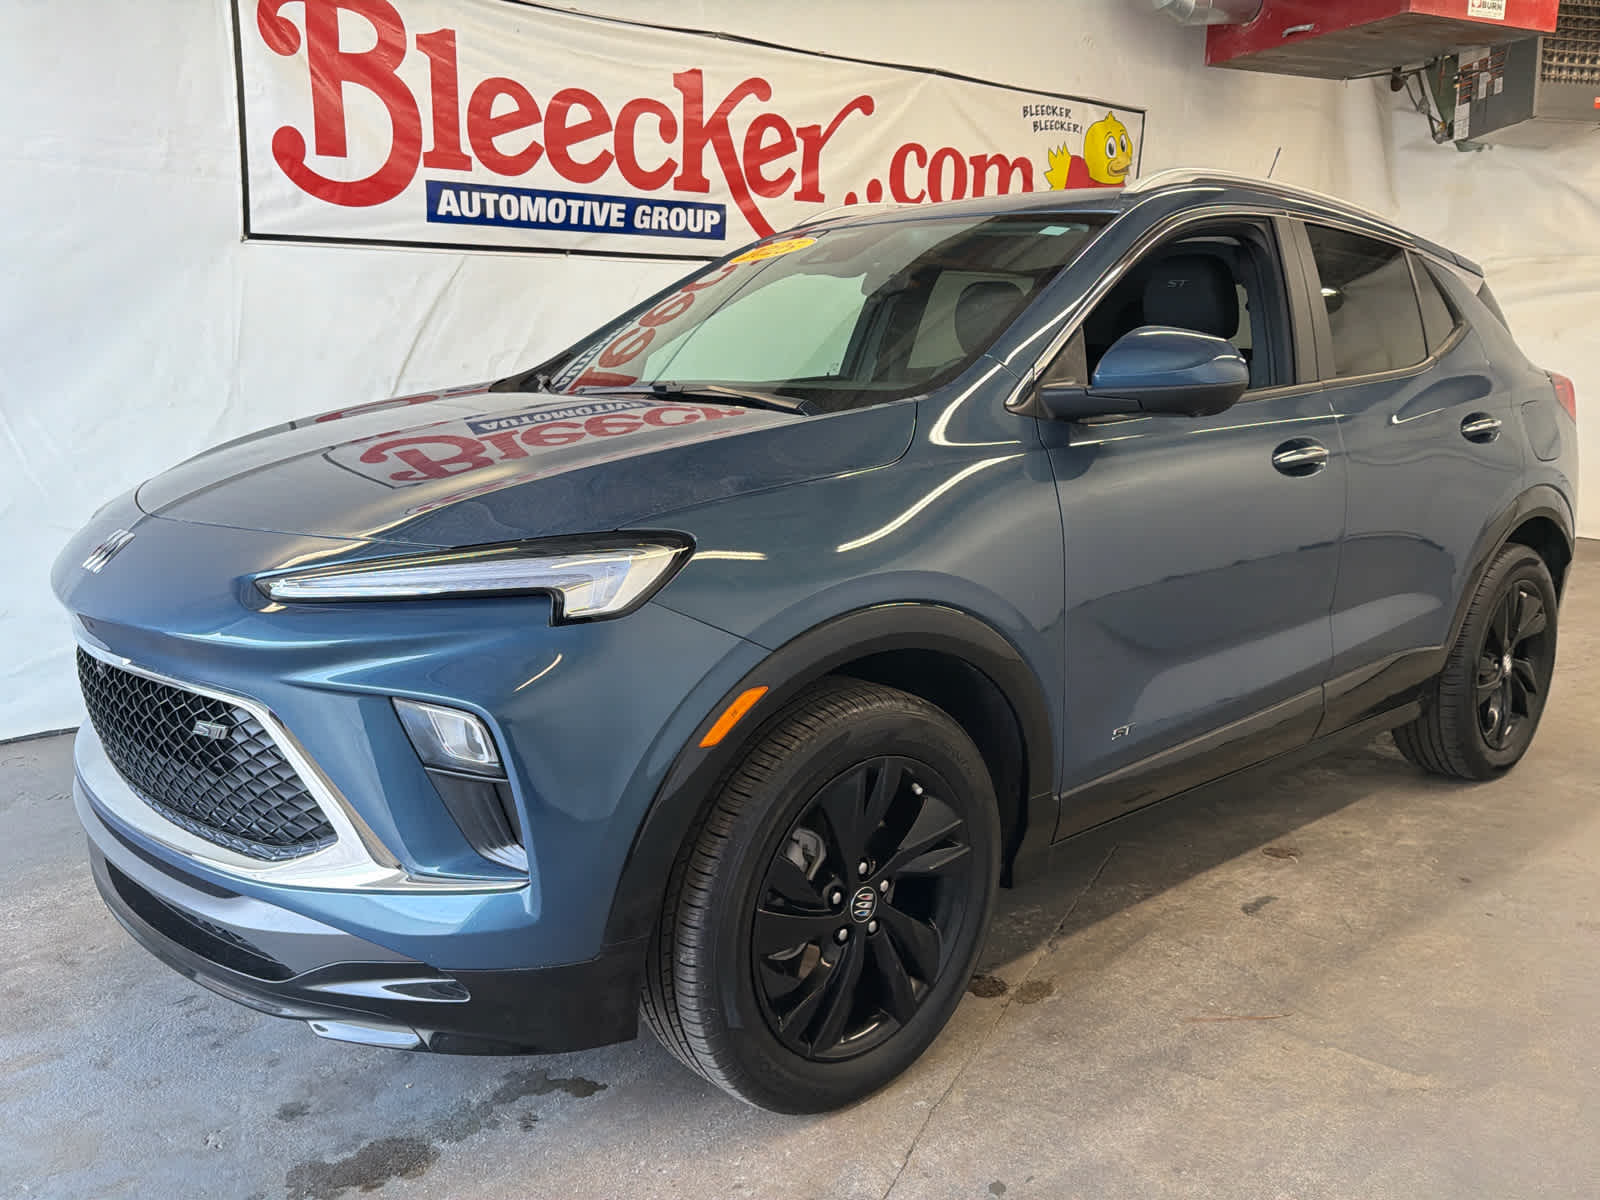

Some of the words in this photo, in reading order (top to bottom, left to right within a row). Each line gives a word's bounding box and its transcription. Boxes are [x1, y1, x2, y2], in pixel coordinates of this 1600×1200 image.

[437, 189, 625, 228] AUTOMOTIVE
[633, 205, 721, 233] GROUP
[1167, 279, 1191, 288] ST
[1111, 721, 1137, 741] ST
